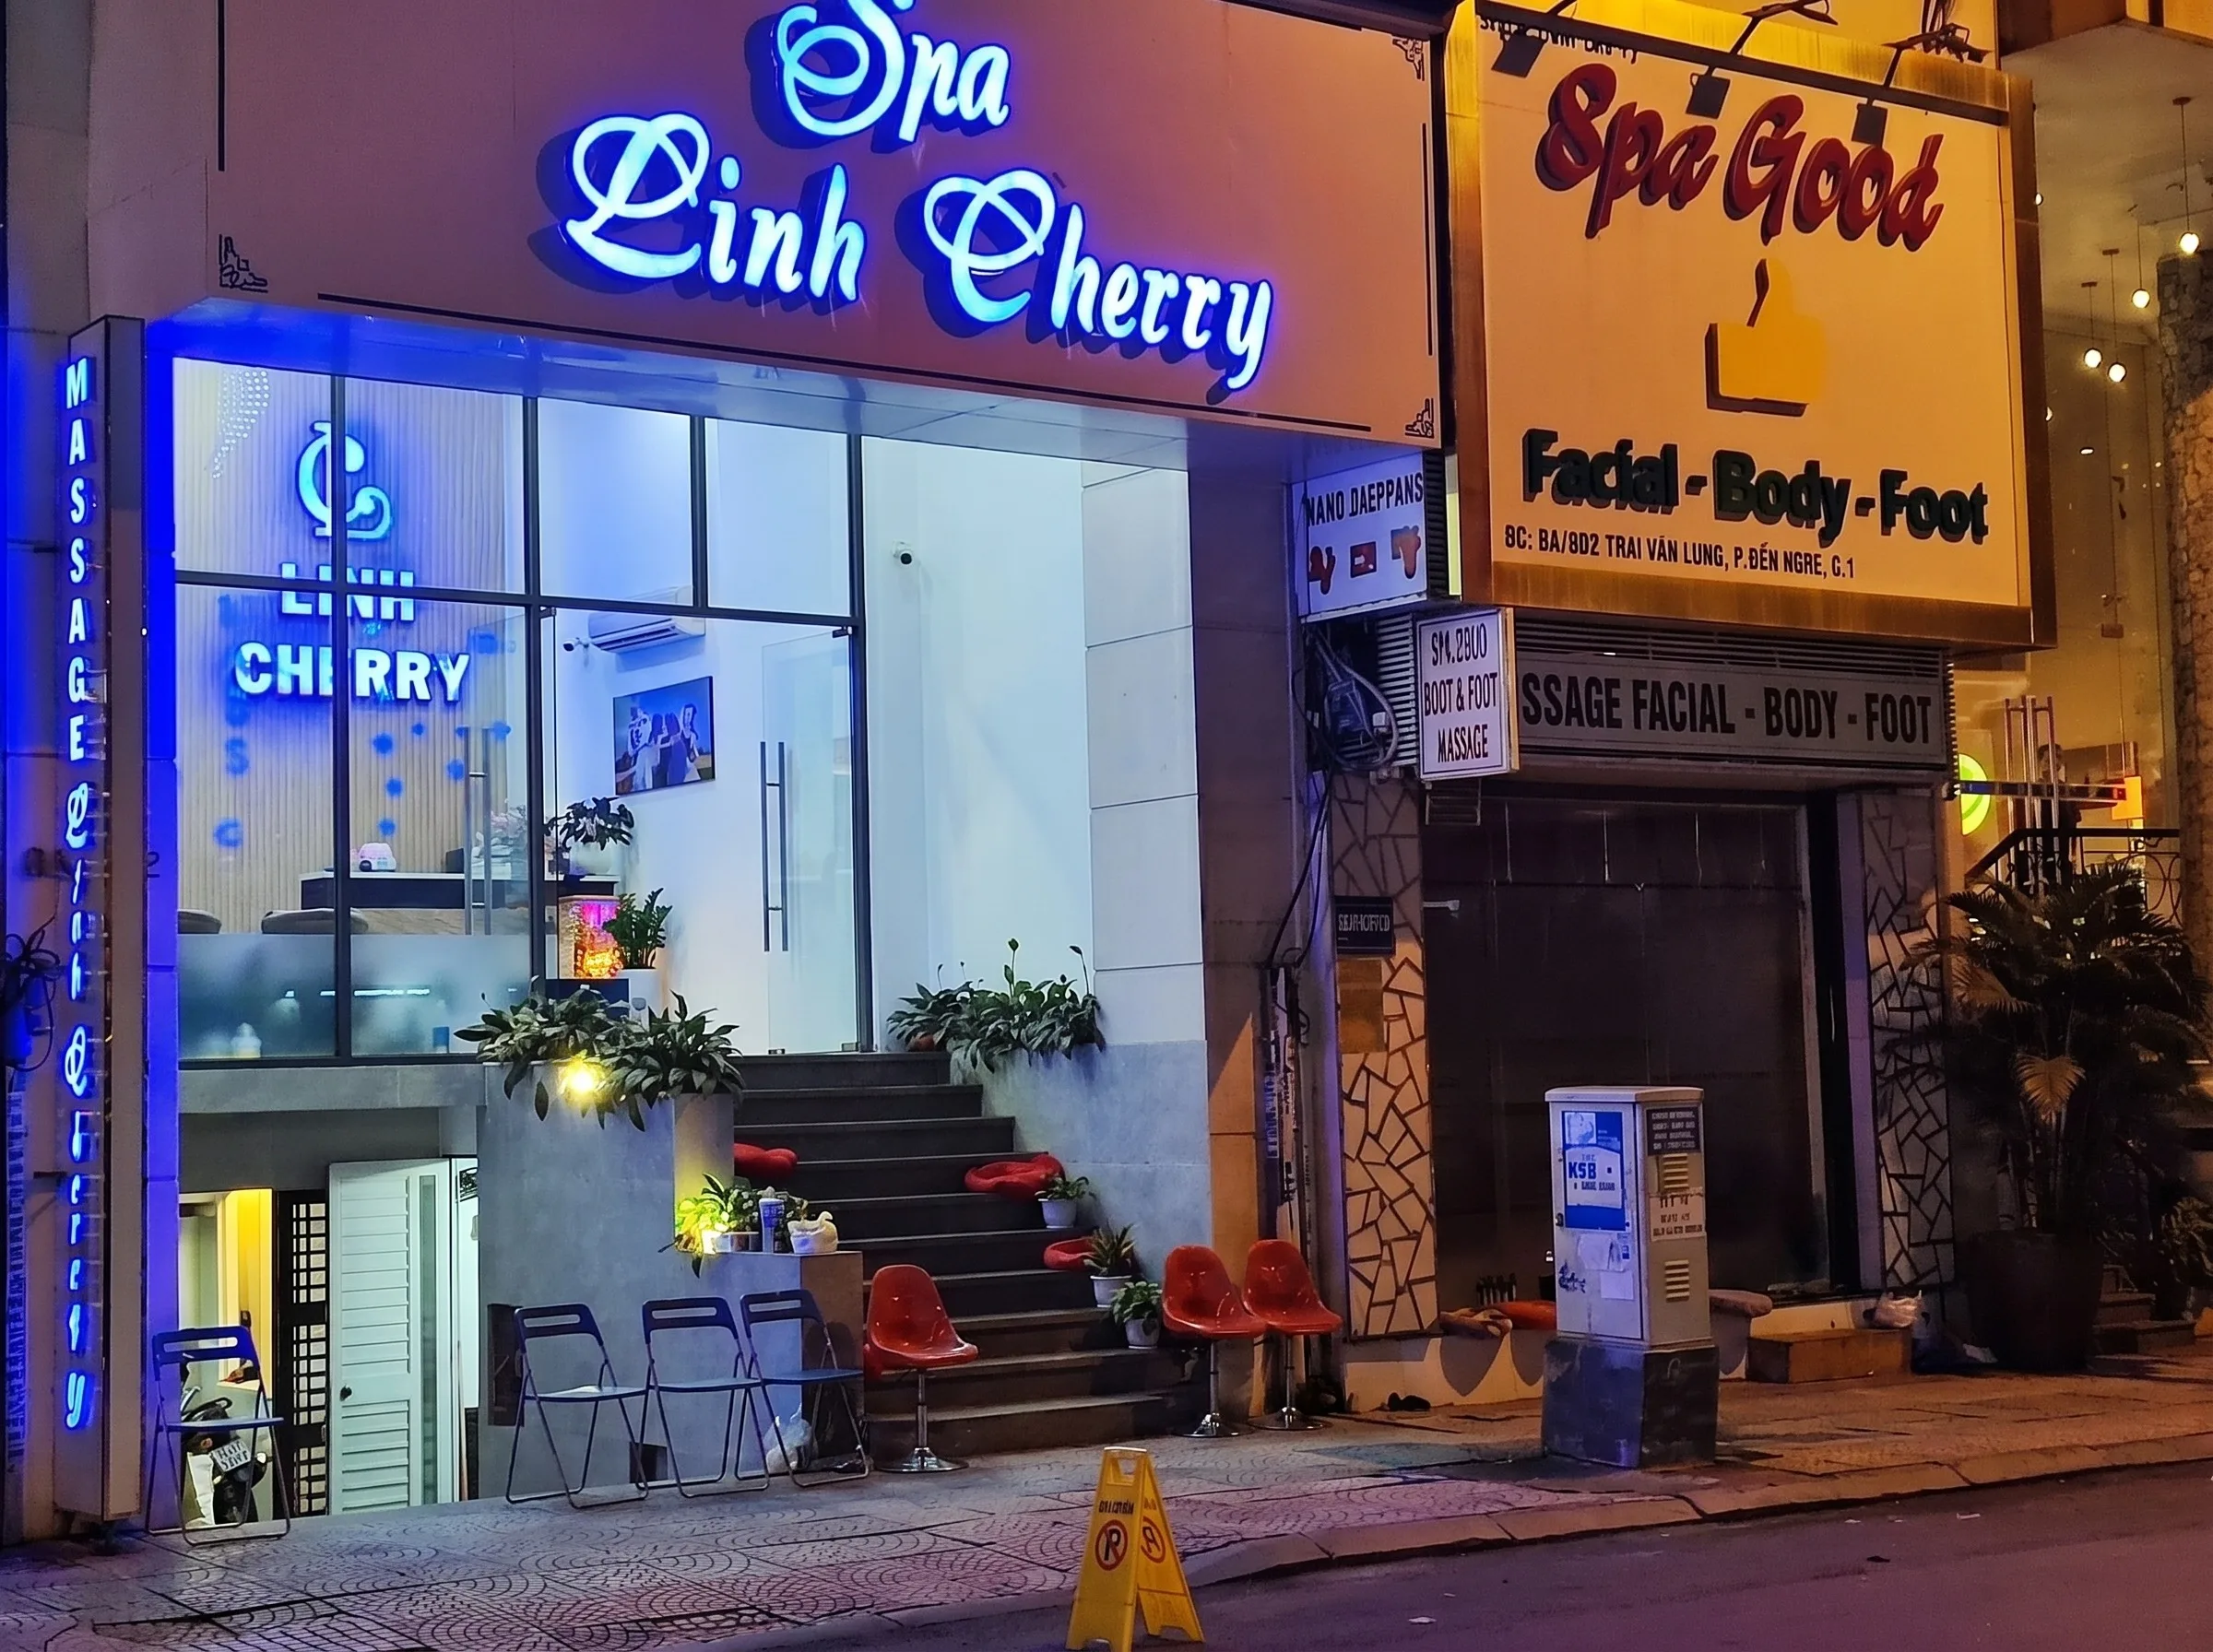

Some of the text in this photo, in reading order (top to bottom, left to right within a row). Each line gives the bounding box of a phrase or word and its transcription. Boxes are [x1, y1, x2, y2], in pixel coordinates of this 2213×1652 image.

[779, 0, 1011, 142] Spa
[1534, 63, 1944, 253] Spa Good
[924, 169, 1272, 389] Cherry
[1522, 429, 1679, 514] Facial
[1713, 450, 1851, 548] Body
[1880, 468, 1989, 544] Foot
[66, 357, 89, 761] MASSAGE
[1683, 541, 1729, 572] LUNG,
[1424, 672, 1497, 716] BOOT & FOOT
[1438, 724, 1488, 763] MASSAGE
[1632, 679, 1736, 734] FACIAL
[1763, 687, 1839, 739] BODY
[1864, 691, 1932, 744] FOOT
